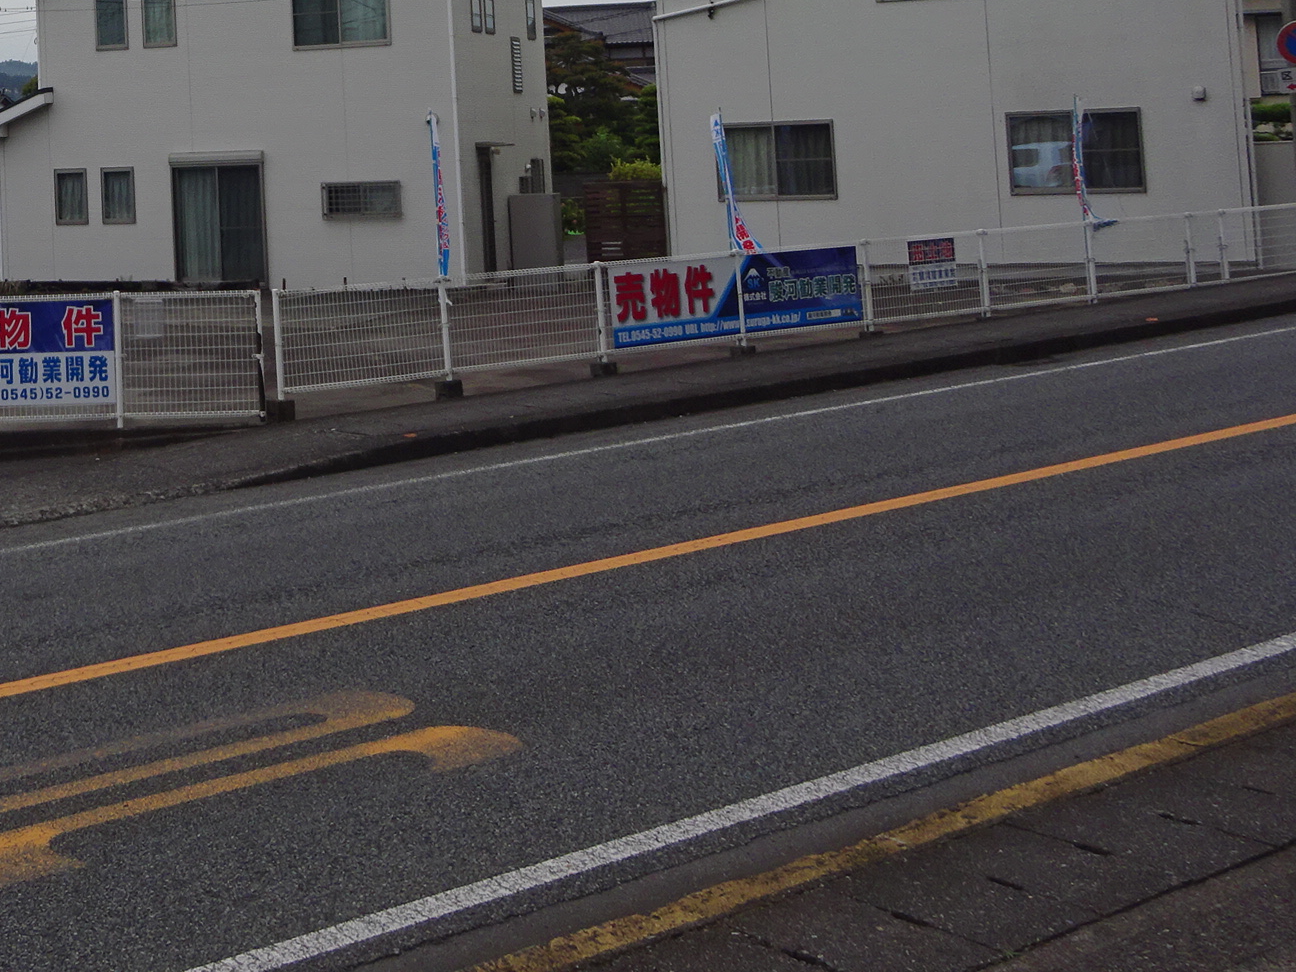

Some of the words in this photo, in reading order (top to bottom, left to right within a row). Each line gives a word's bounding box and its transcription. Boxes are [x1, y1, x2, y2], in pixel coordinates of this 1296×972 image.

[766, 266, 791, 279] 不動産
[747, 278, 761, 289] SK
[614, 265, 714, 322] 売物件
[743, 291, 767, 302] 株式会社
